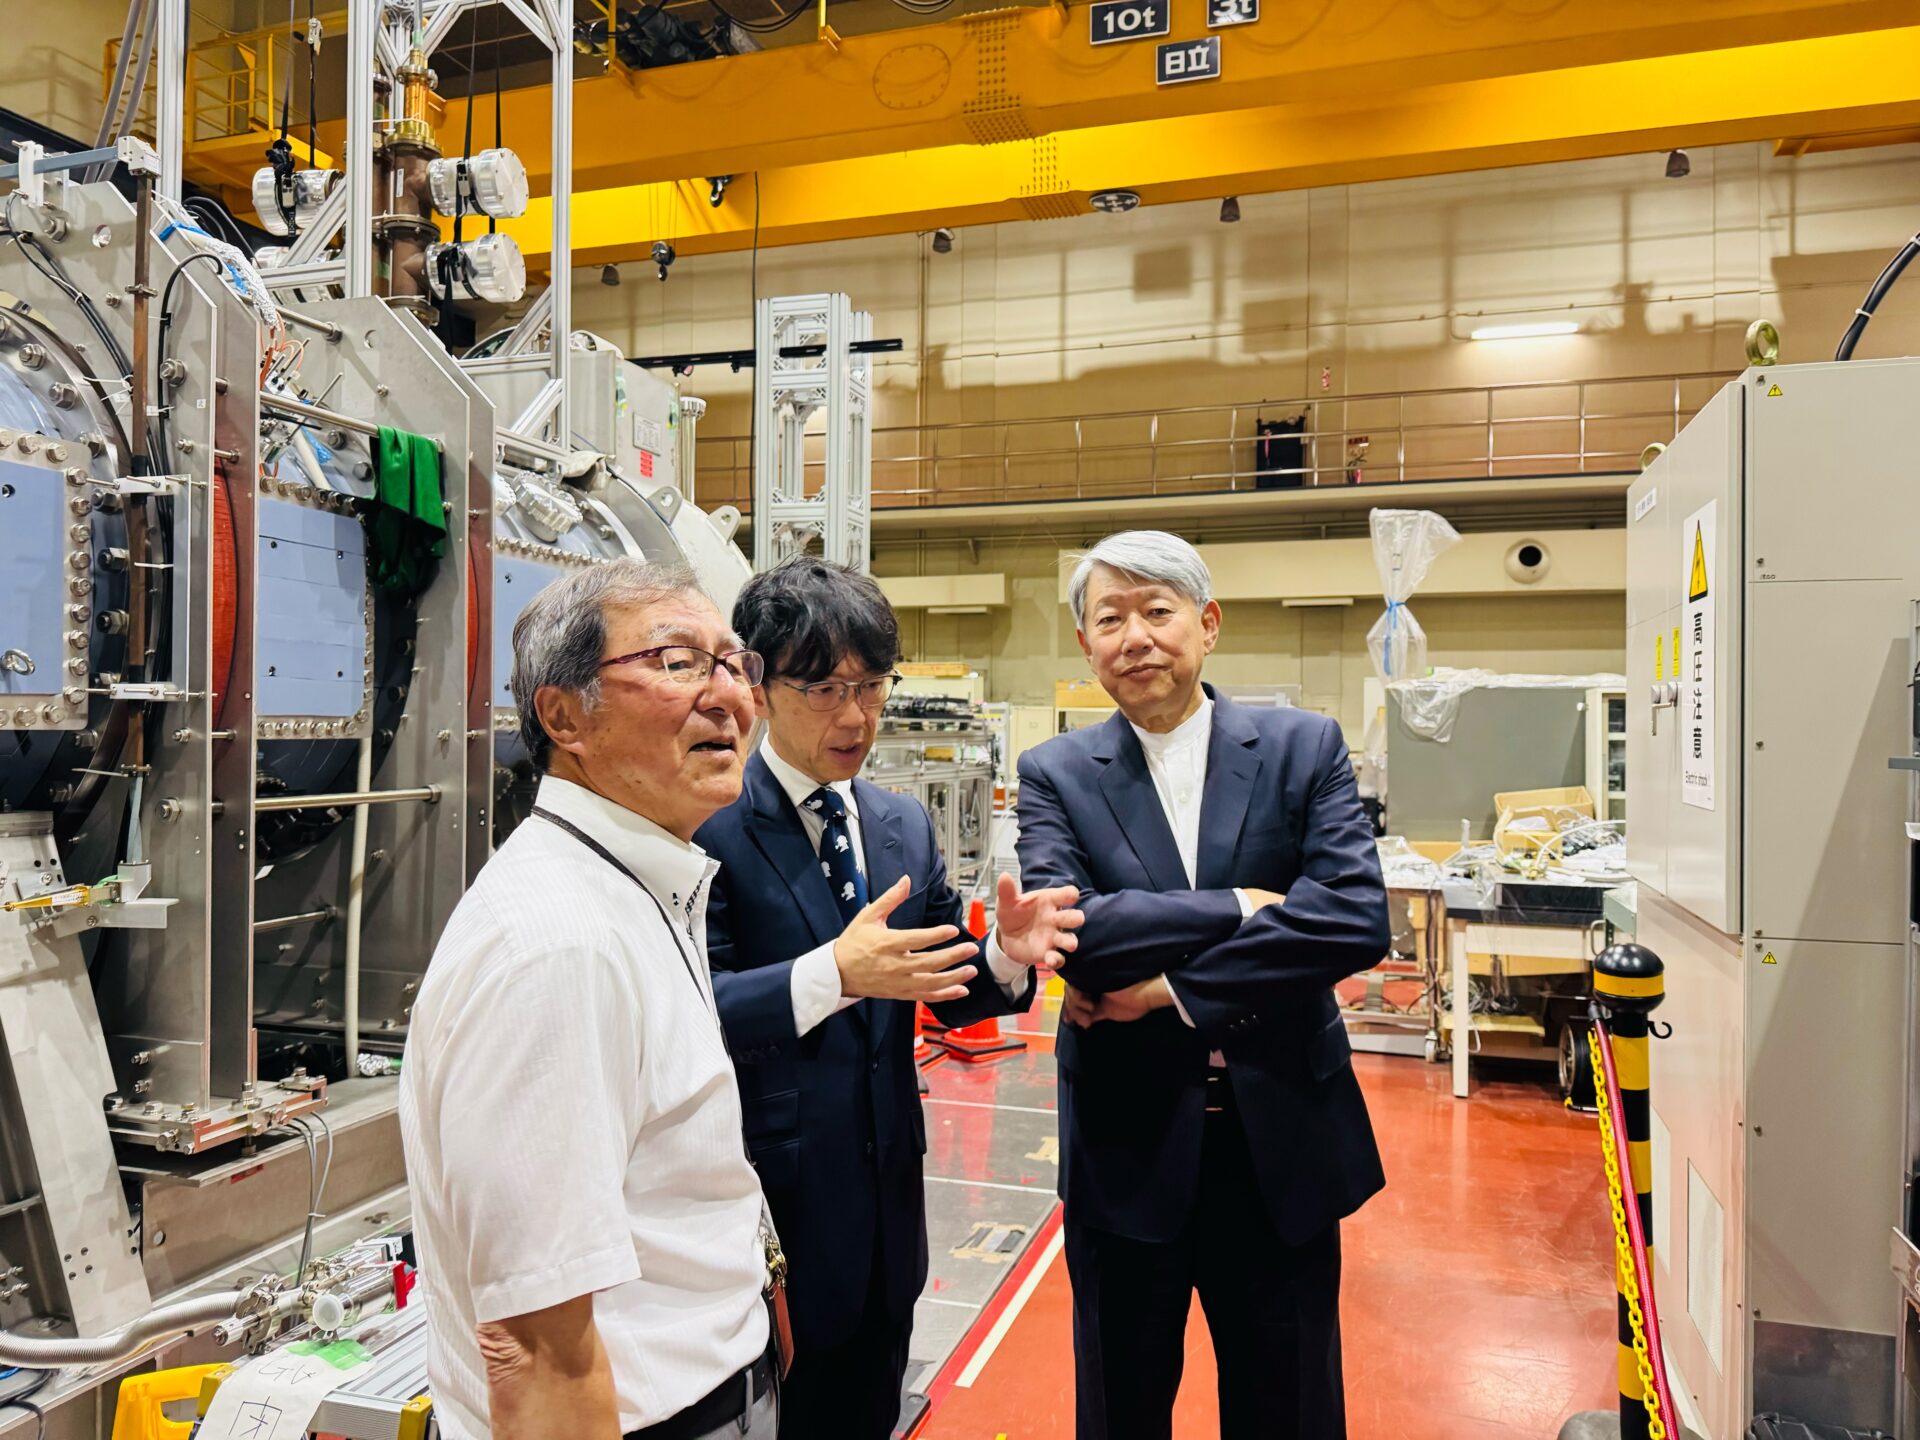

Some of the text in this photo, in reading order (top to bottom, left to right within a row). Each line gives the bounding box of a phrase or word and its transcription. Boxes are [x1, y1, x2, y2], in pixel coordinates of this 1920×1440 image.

[1103, 6, 1156, 34] 10t
[1212, 0, 1253, 17] 3t
[1165, 45, 1210, 75] 日立
